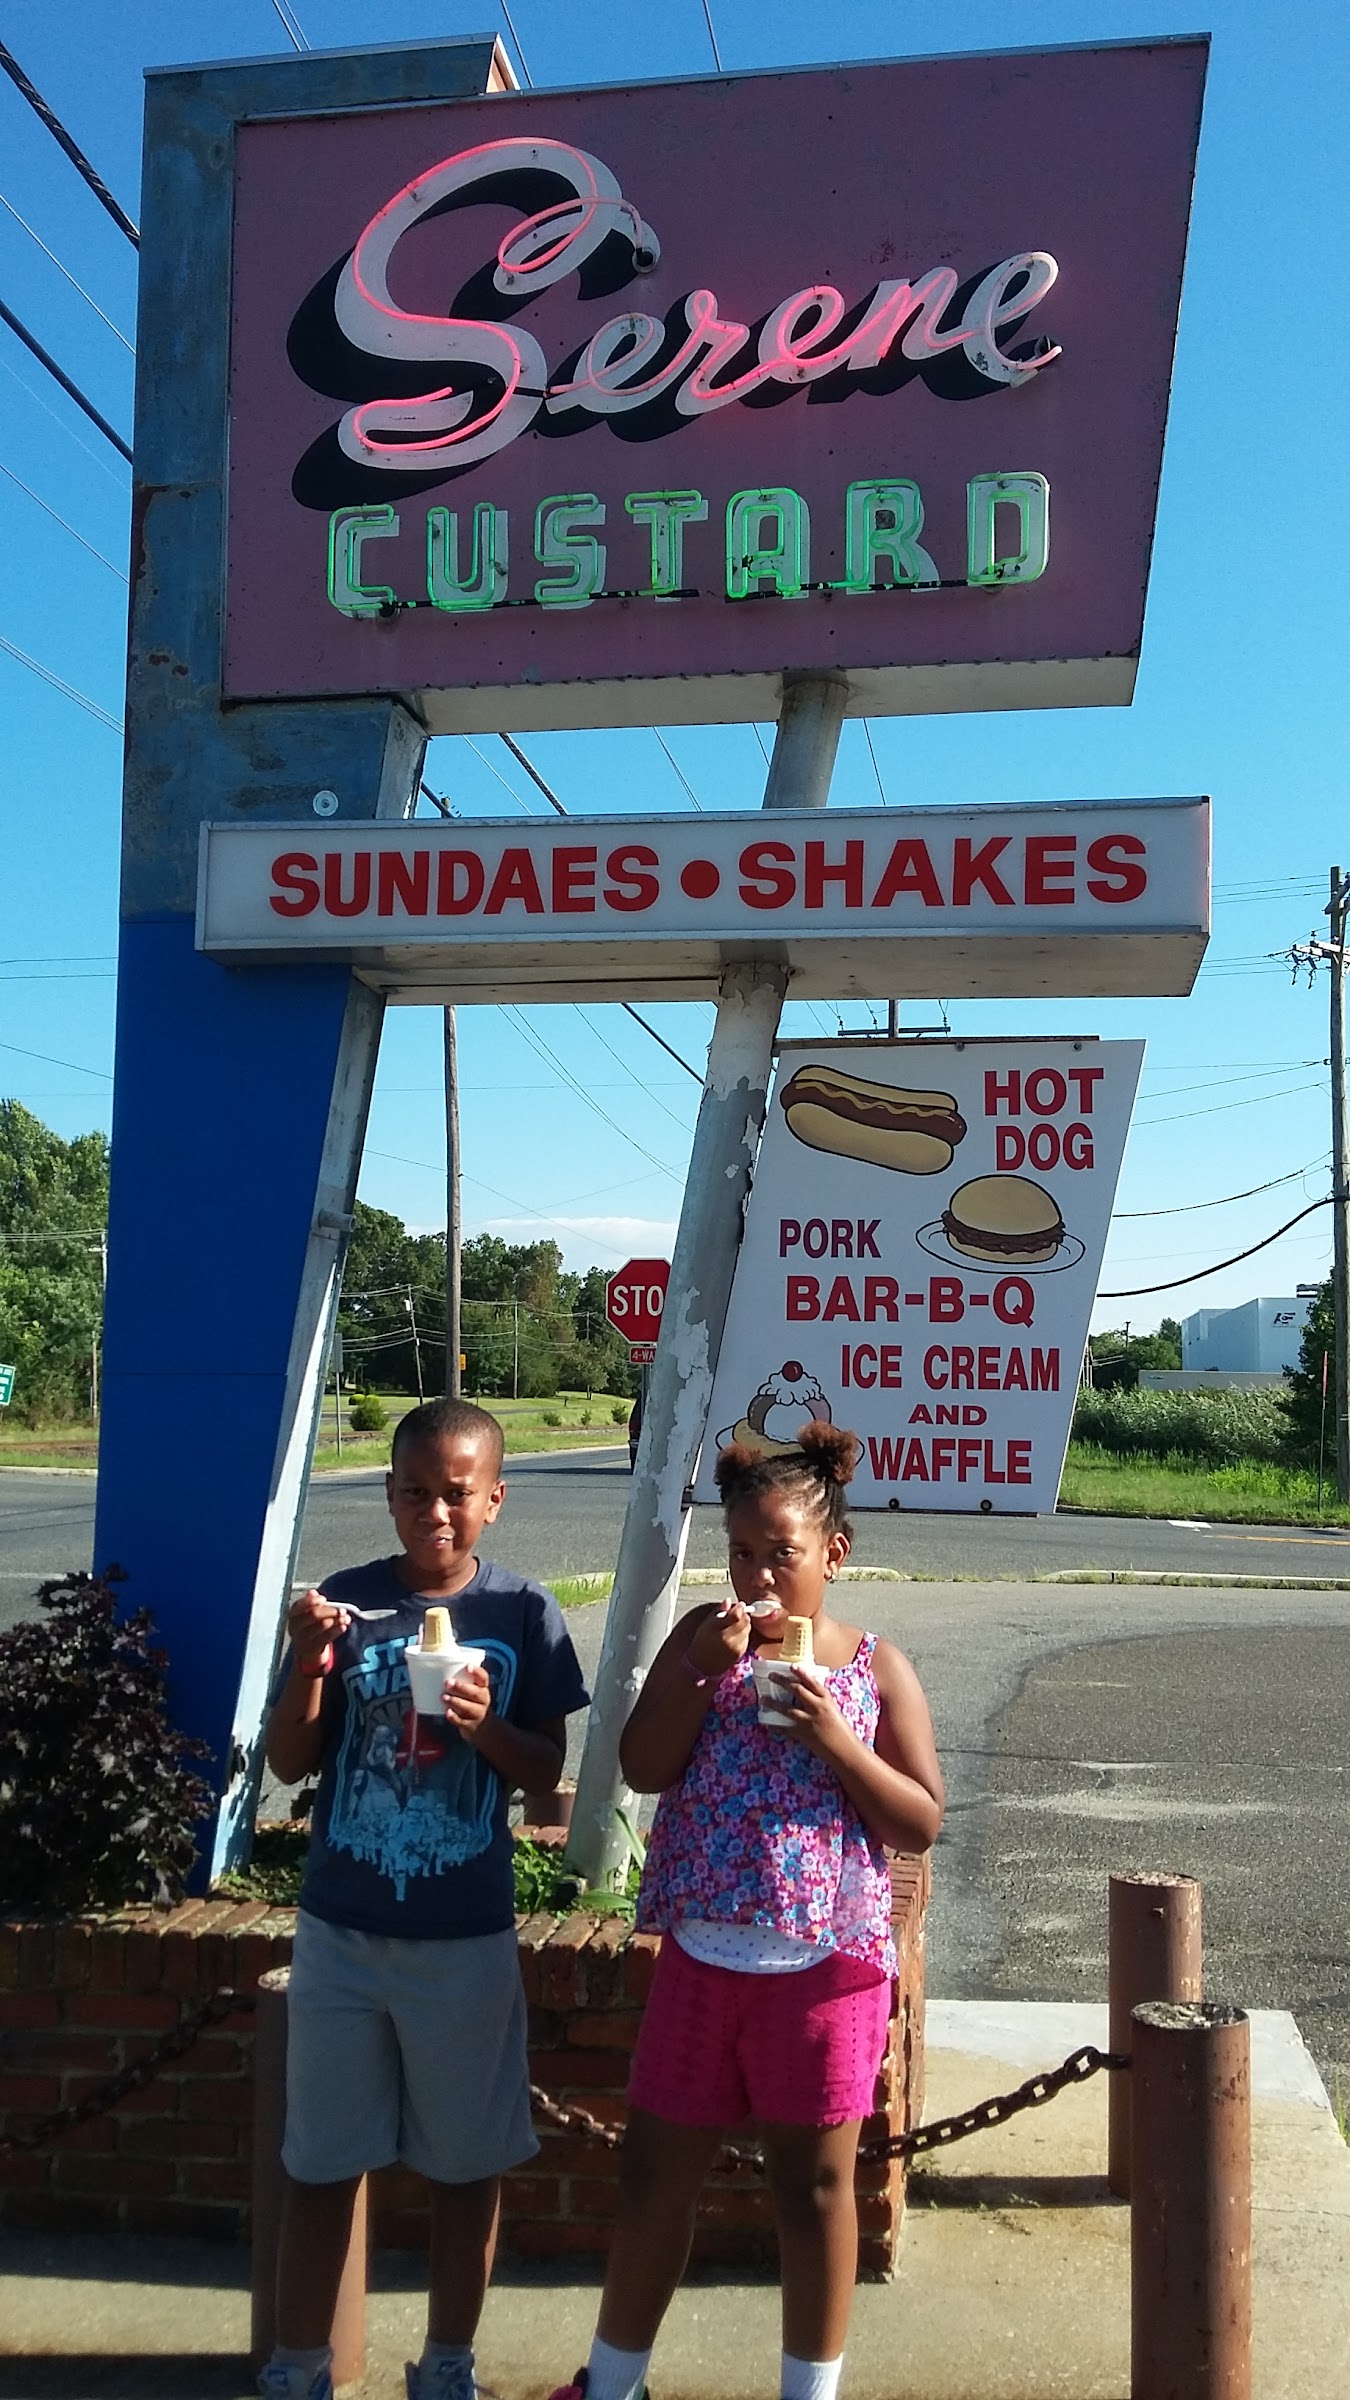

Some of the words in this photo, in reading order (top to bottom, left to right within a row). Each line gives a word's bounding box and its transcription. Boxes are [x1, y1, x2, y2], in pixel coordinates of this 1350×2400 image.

[334, 136, 1063, 470] Serene
[327, 471, 1051, 619] CUSTARD
[268, 843, 660, 917] SUNDAES
[737, 833, 1148, 910] SHAKES
[984, 1067, 1104, 1116] HOT
[996, 1123, 1095, 1171] DOG
[779, 1218, 882, 1259] PORK
[611, 1285, 665, 1316] STO
[785, 1275, 1036, 1328] BAR-B-Q
[631, 1350, 656, 1361] 4-WA
[841, 1344, 903, 1389] ICE
[923, 1345, 1061, 1392] CREAM
[907, 1404, 988, 1426] AND
[867, 1436, 1033, 1484] WAFFLE
[360, 1634, 419, 1673] ST
[349, 1665, 412, 1700] WA
